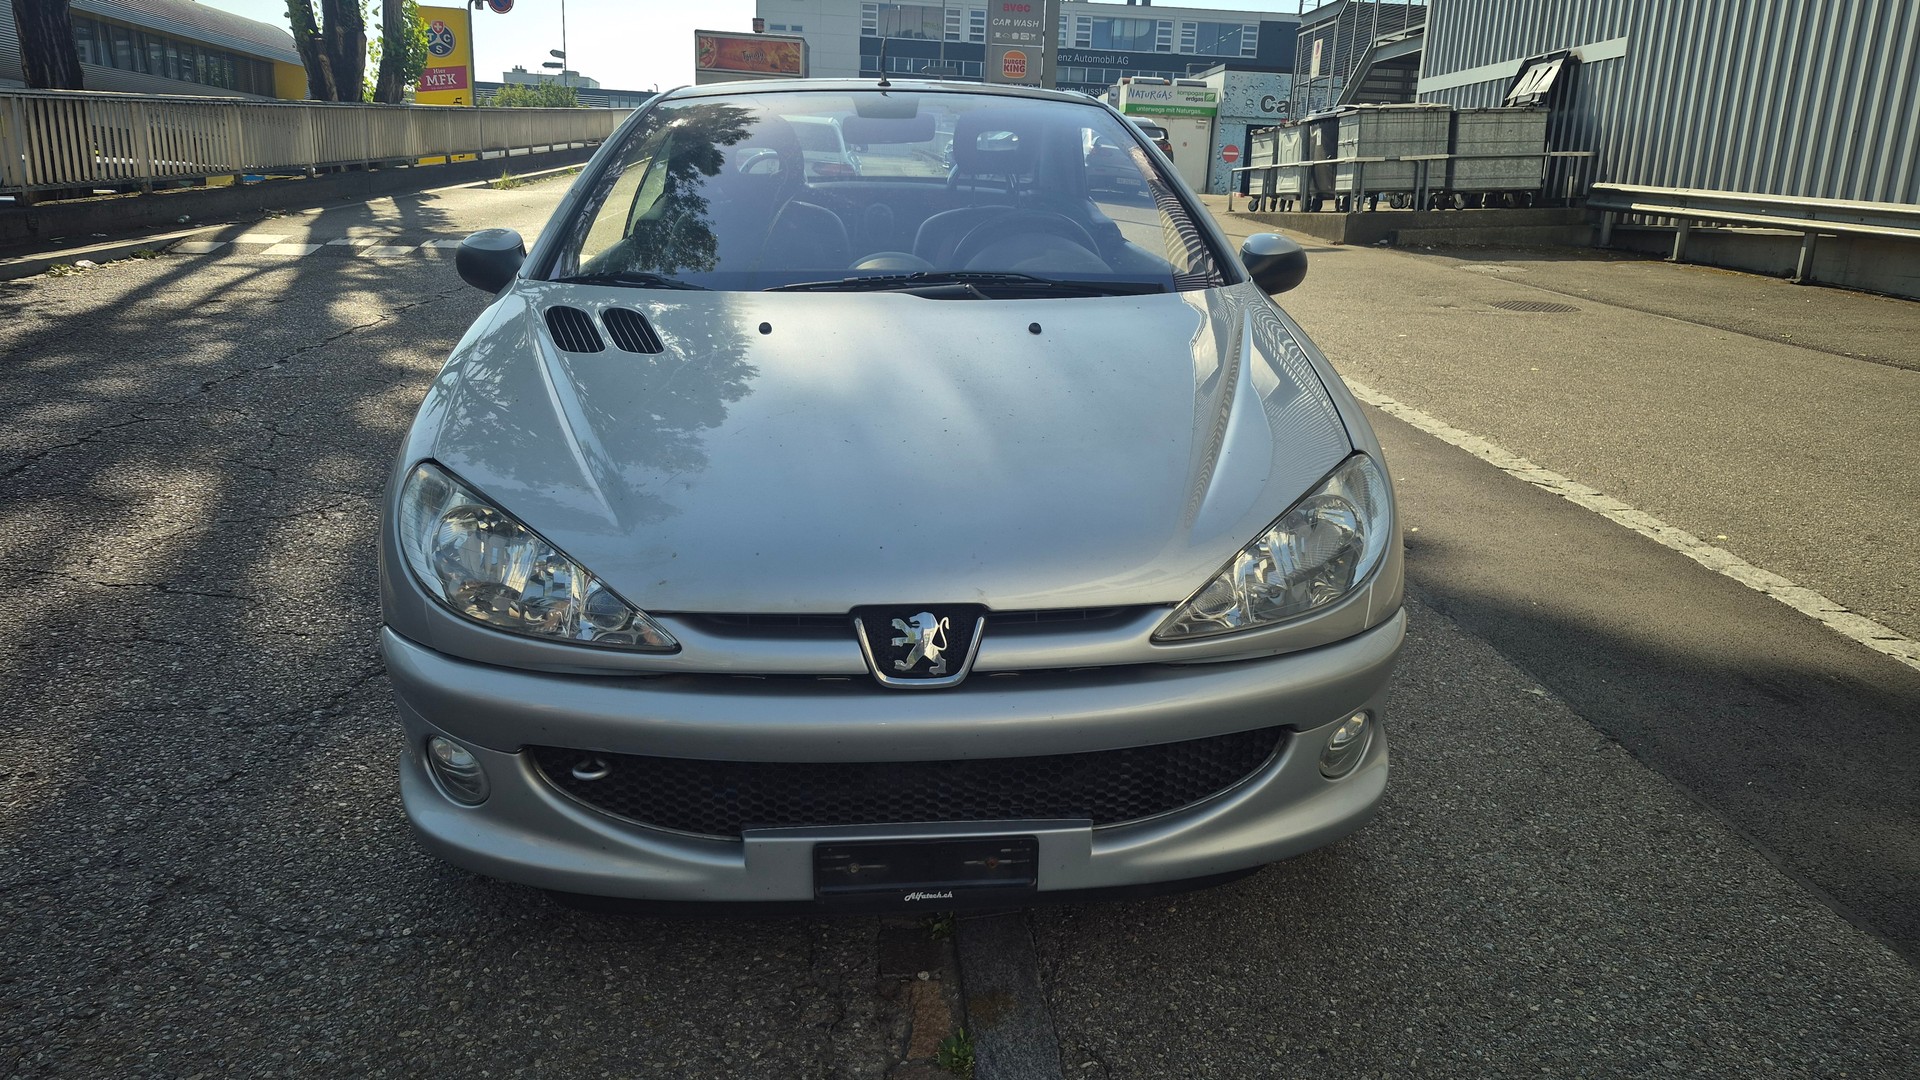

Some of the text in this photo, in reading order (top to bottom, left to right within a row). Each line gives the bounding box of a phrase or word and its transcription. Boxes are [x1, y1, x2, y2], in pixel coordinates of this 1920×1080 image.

[1003, 3, 1030, 12] avec
[992, 18, 1040, 28] CAR WASH
[1074, 53, 1115, 65] Automobil
[1117, 55, 1129, 65] AG
[1003, 64, 1026, 73] KING
[426, 73, 457, 86] MFK
[1128, 87, 1173, 100] NATURGAS
[1136, 106, 1165, 114] unterwegs
[904, 891, 953, 901] Alfatech.ch
